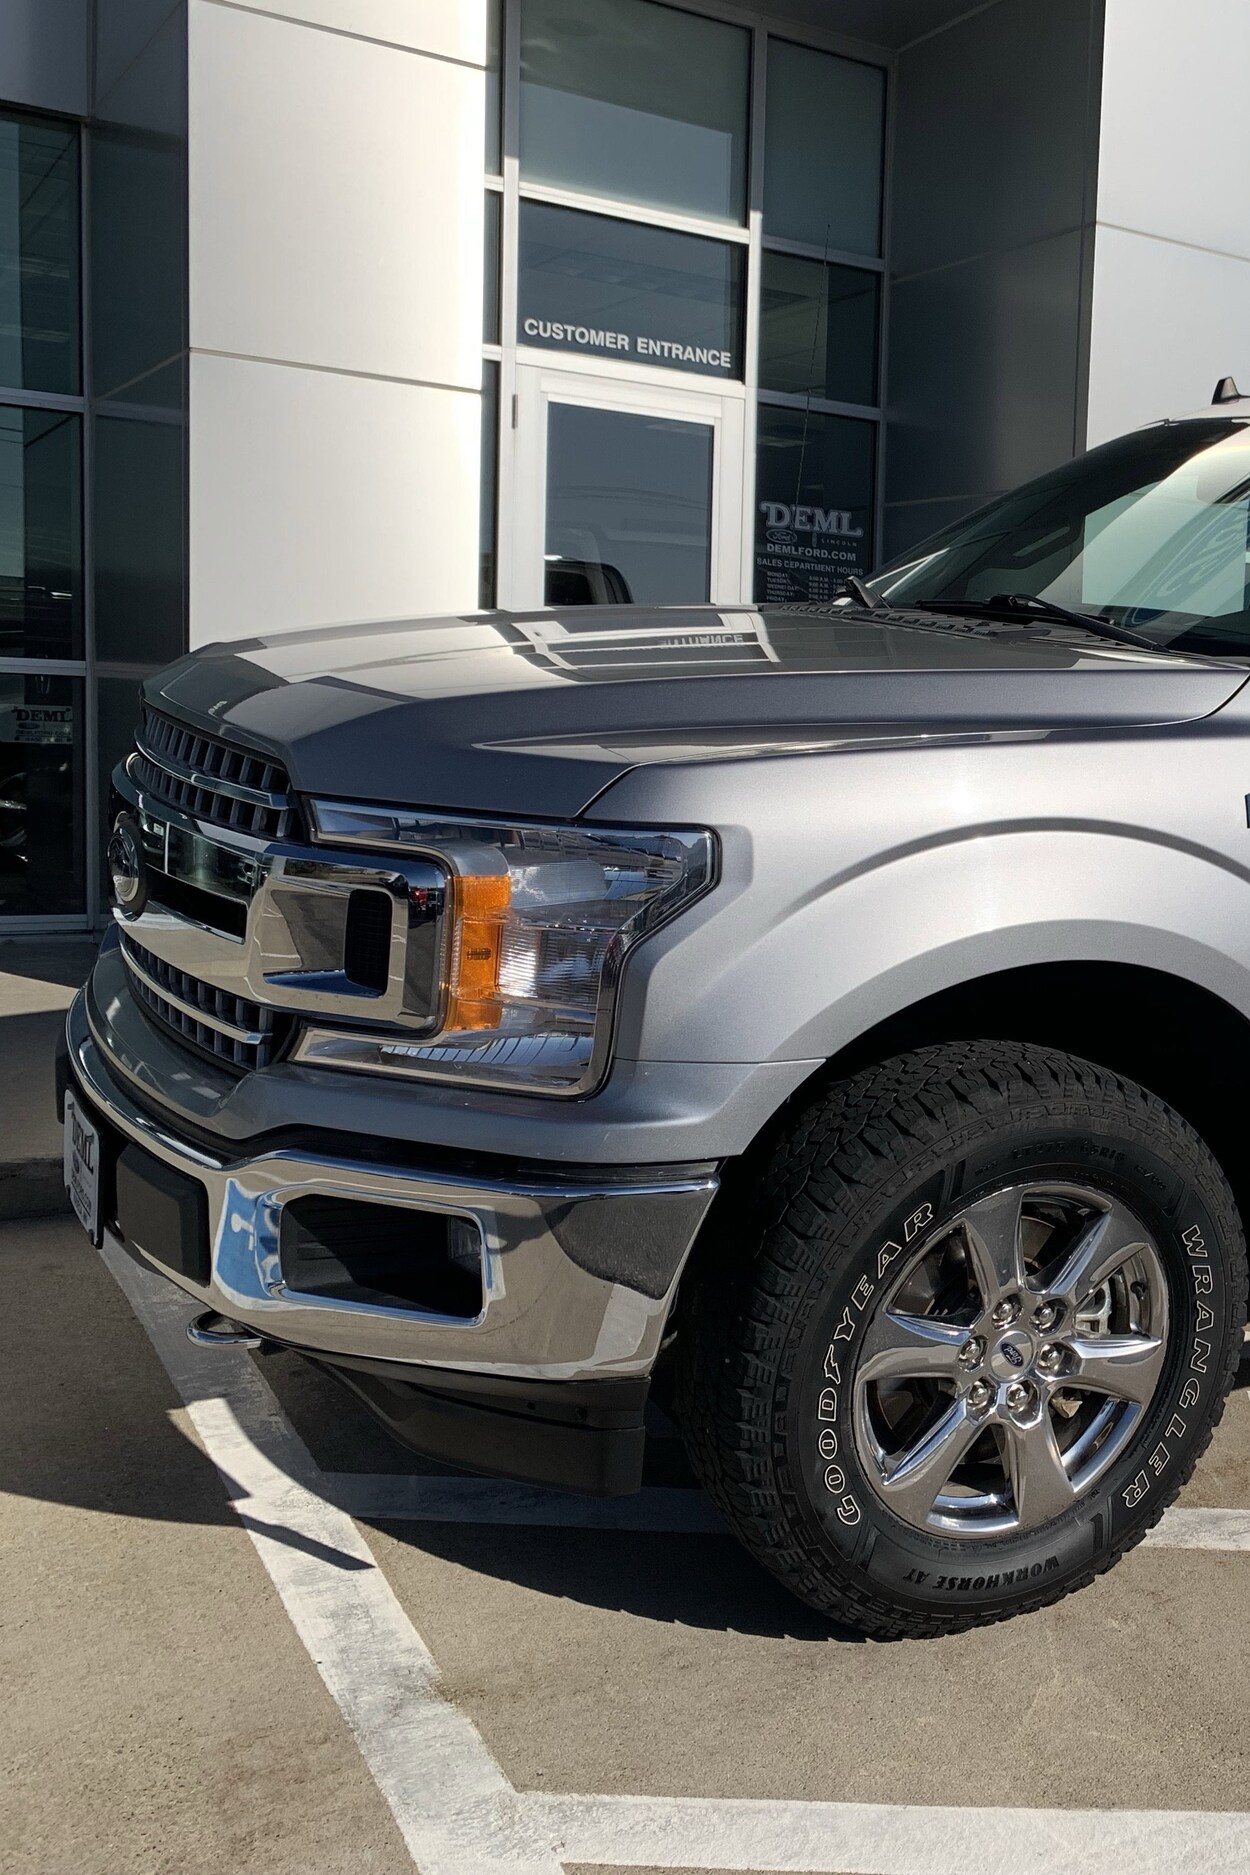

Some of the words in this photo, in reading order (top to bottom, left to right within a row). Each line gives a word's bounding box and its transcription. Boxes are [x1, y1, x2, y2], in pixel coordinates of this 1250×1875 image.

[524, 318, 630, 351] CUSTOMER
[636, 335, 732, 368] ENTRANCE
[760, 501, 864, 538] DEML
[766, 543, 856, 561] DEMLFORD.COM
[821, 539, 857, 547] LINCOLN
[757, 557, 782, 568] SALES
[837, 566, 864, 576] HOURS
[818, 1203, 933, 1526] GOODYEAR
[1122, 1224, 1214, 1508] WRANGLER
[902, 1568, 931, 1585] AT
[932, 1555, 1060, 1591] WORKHORSE
